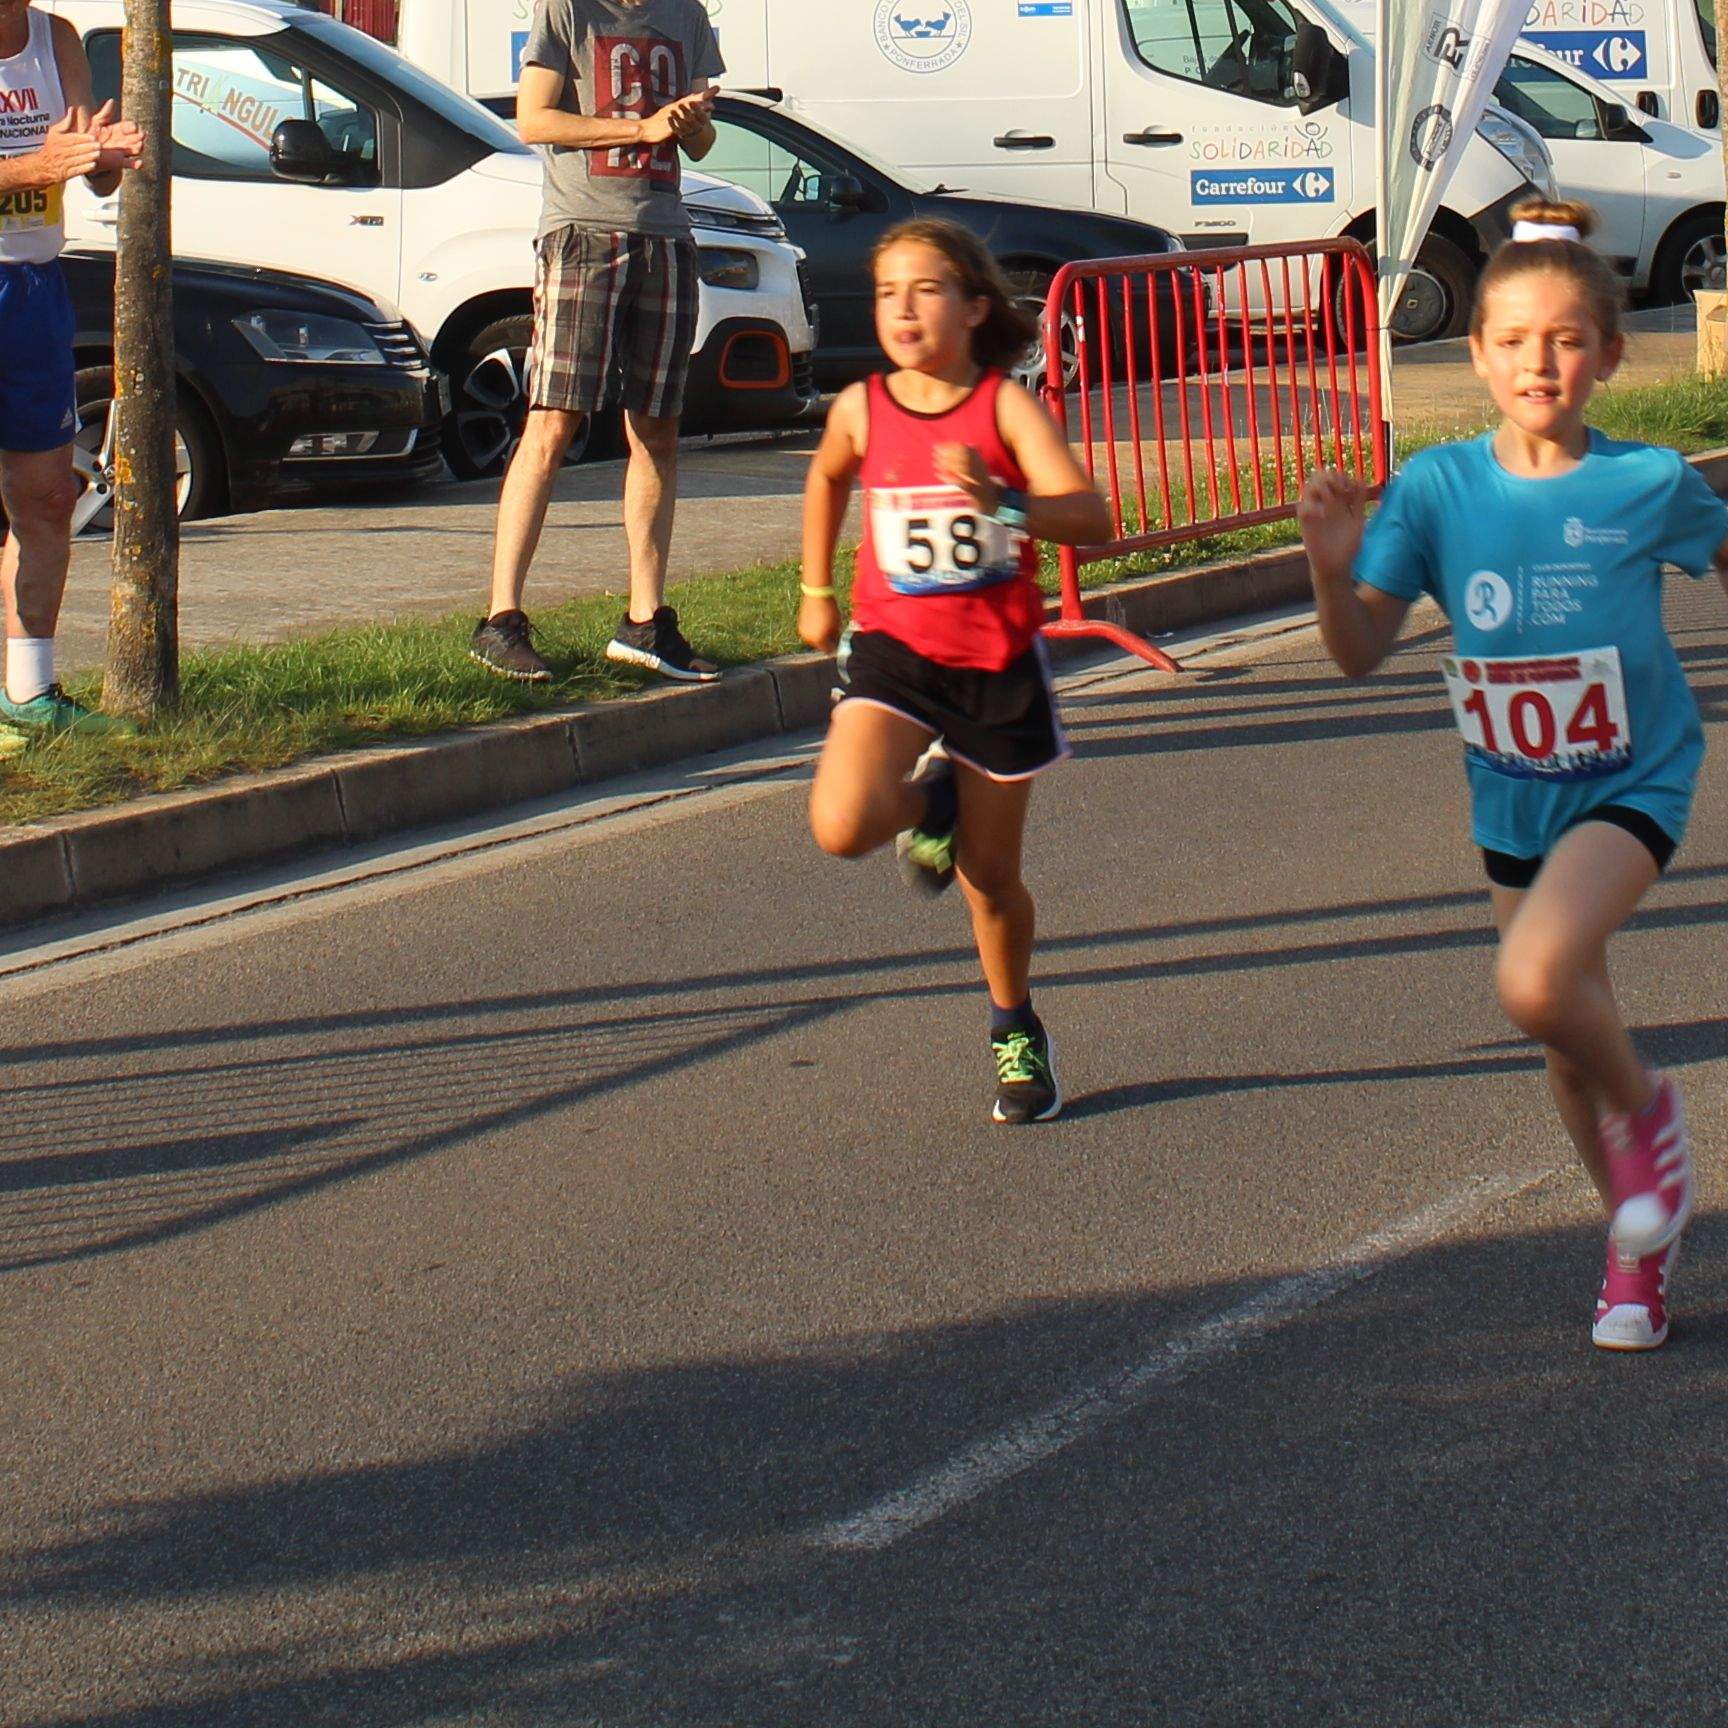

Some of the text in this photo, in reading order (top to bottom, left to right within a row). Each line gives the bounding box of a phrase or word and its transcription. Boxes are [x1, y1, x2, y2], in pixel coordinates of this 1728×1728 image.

[1196, 177, 1286, 196] Carrefour
[908, 514, 981, 573] 58
[1463, 682, 1618, 759] 104
